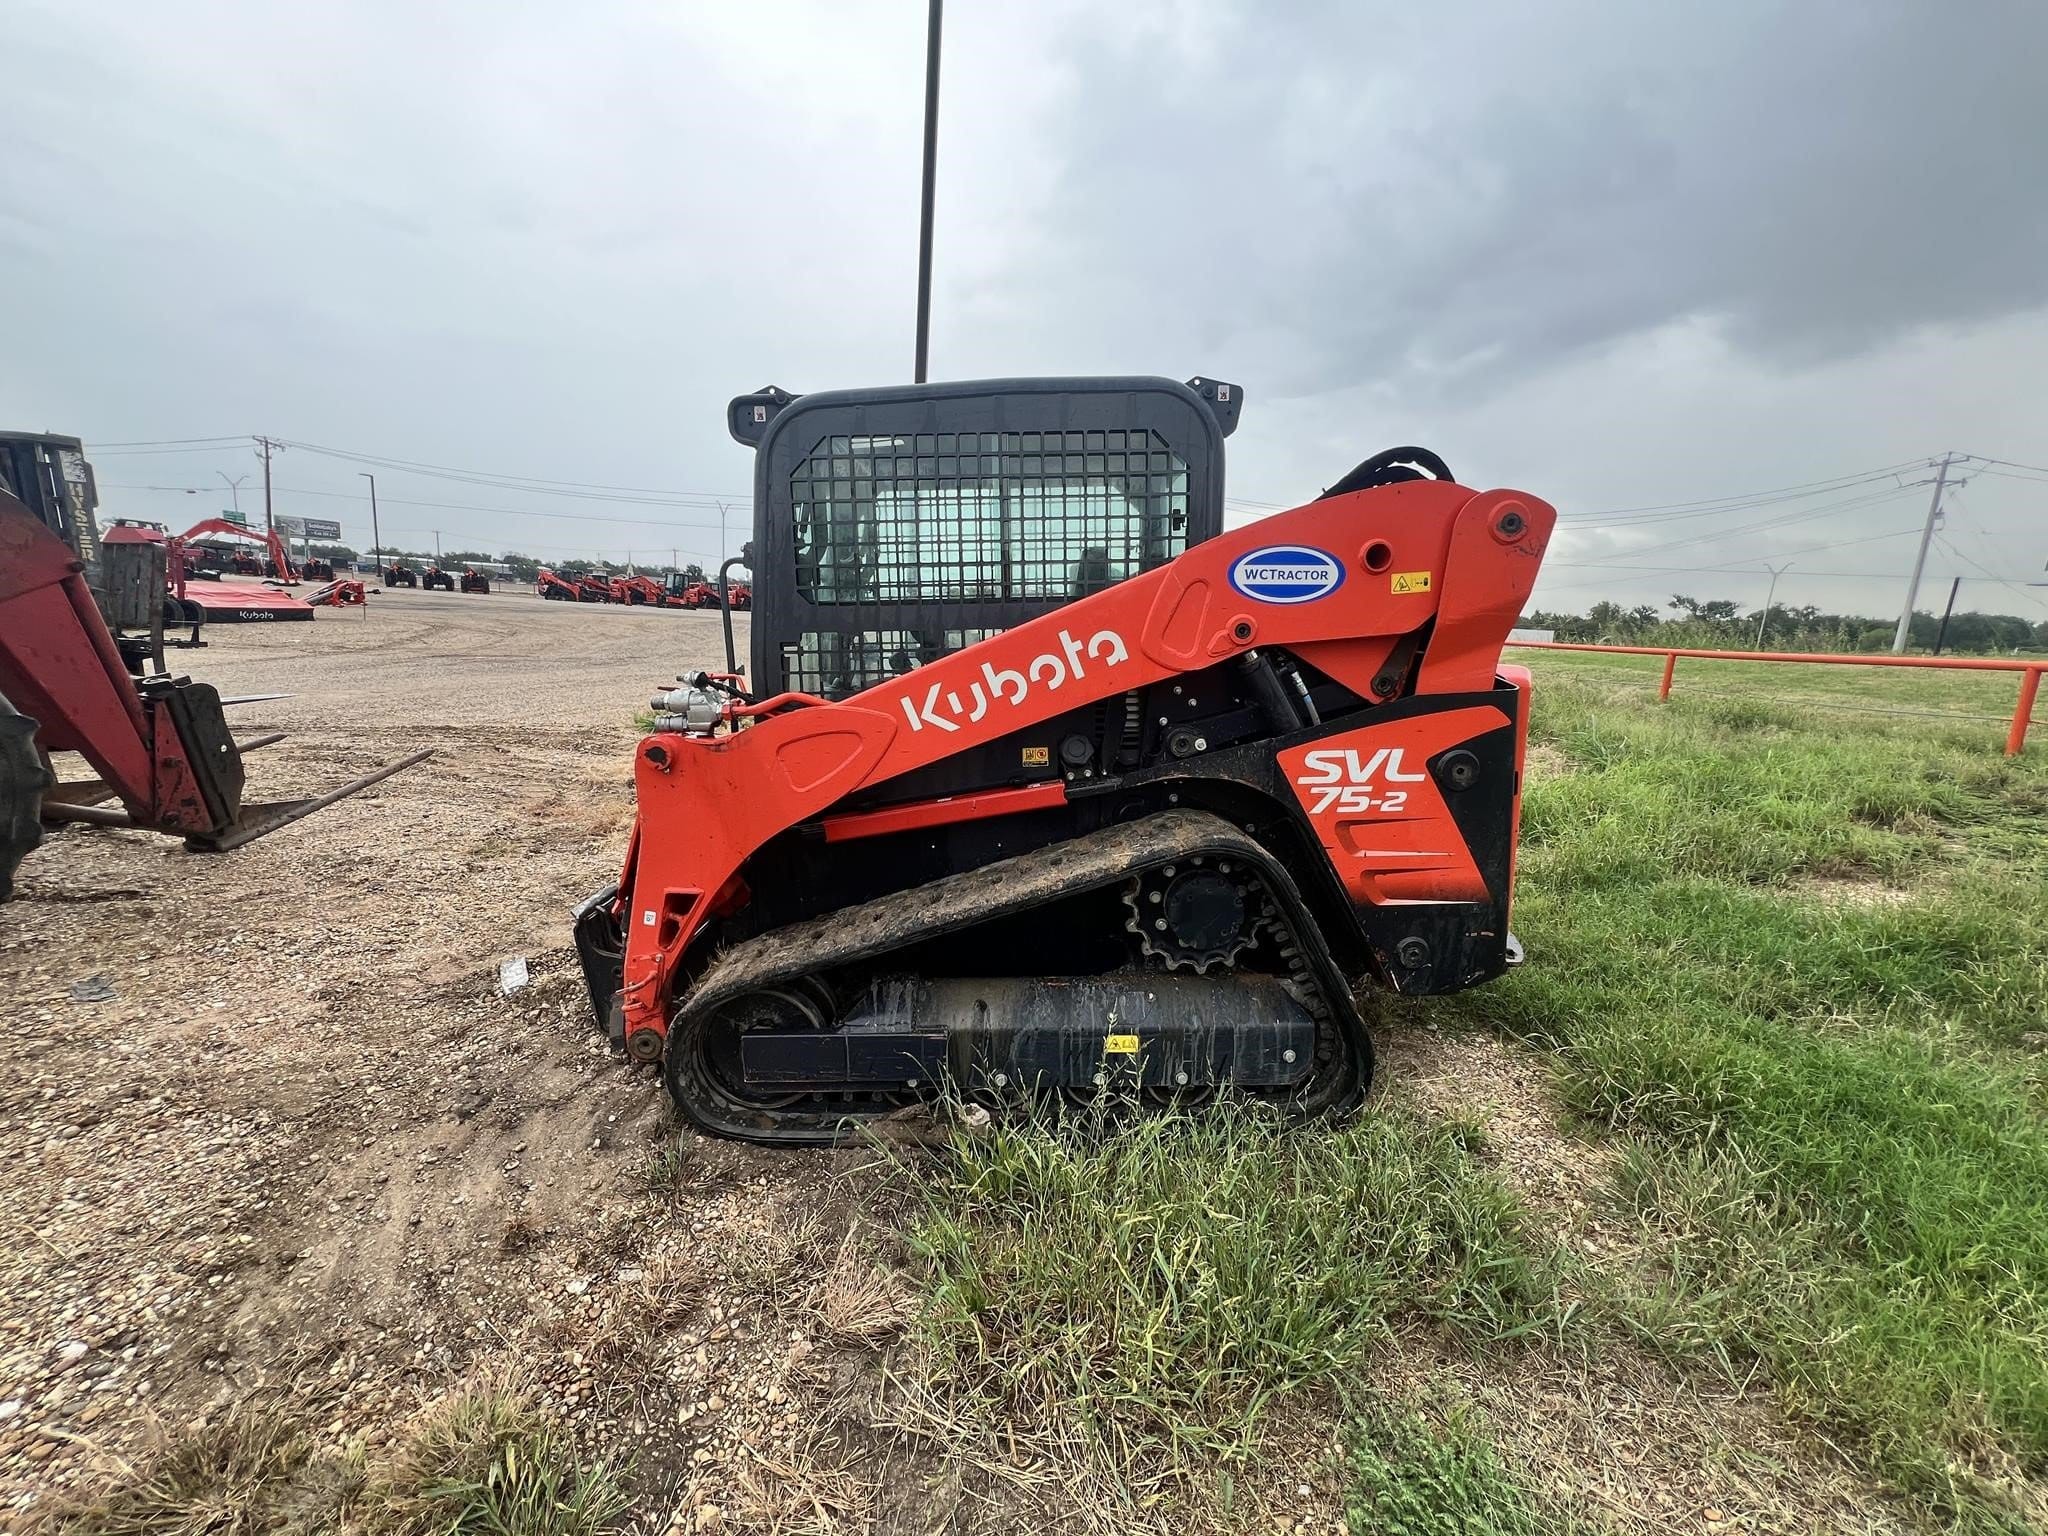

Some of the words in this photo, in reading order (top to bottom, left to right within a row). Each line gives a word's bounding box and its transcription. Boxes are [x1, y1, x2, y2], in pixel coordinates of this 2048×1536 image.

[68, 482, 95, 561] HYSTER
[1244, 568, 1329, 581] WCTRACTOR
[239, 610, 274, 619] Kubota
[899, 629, 1129, 732] Kubota
[1297, 748, 1427, 785] SVL
[1308, 786, 1407, 814] 75-2
